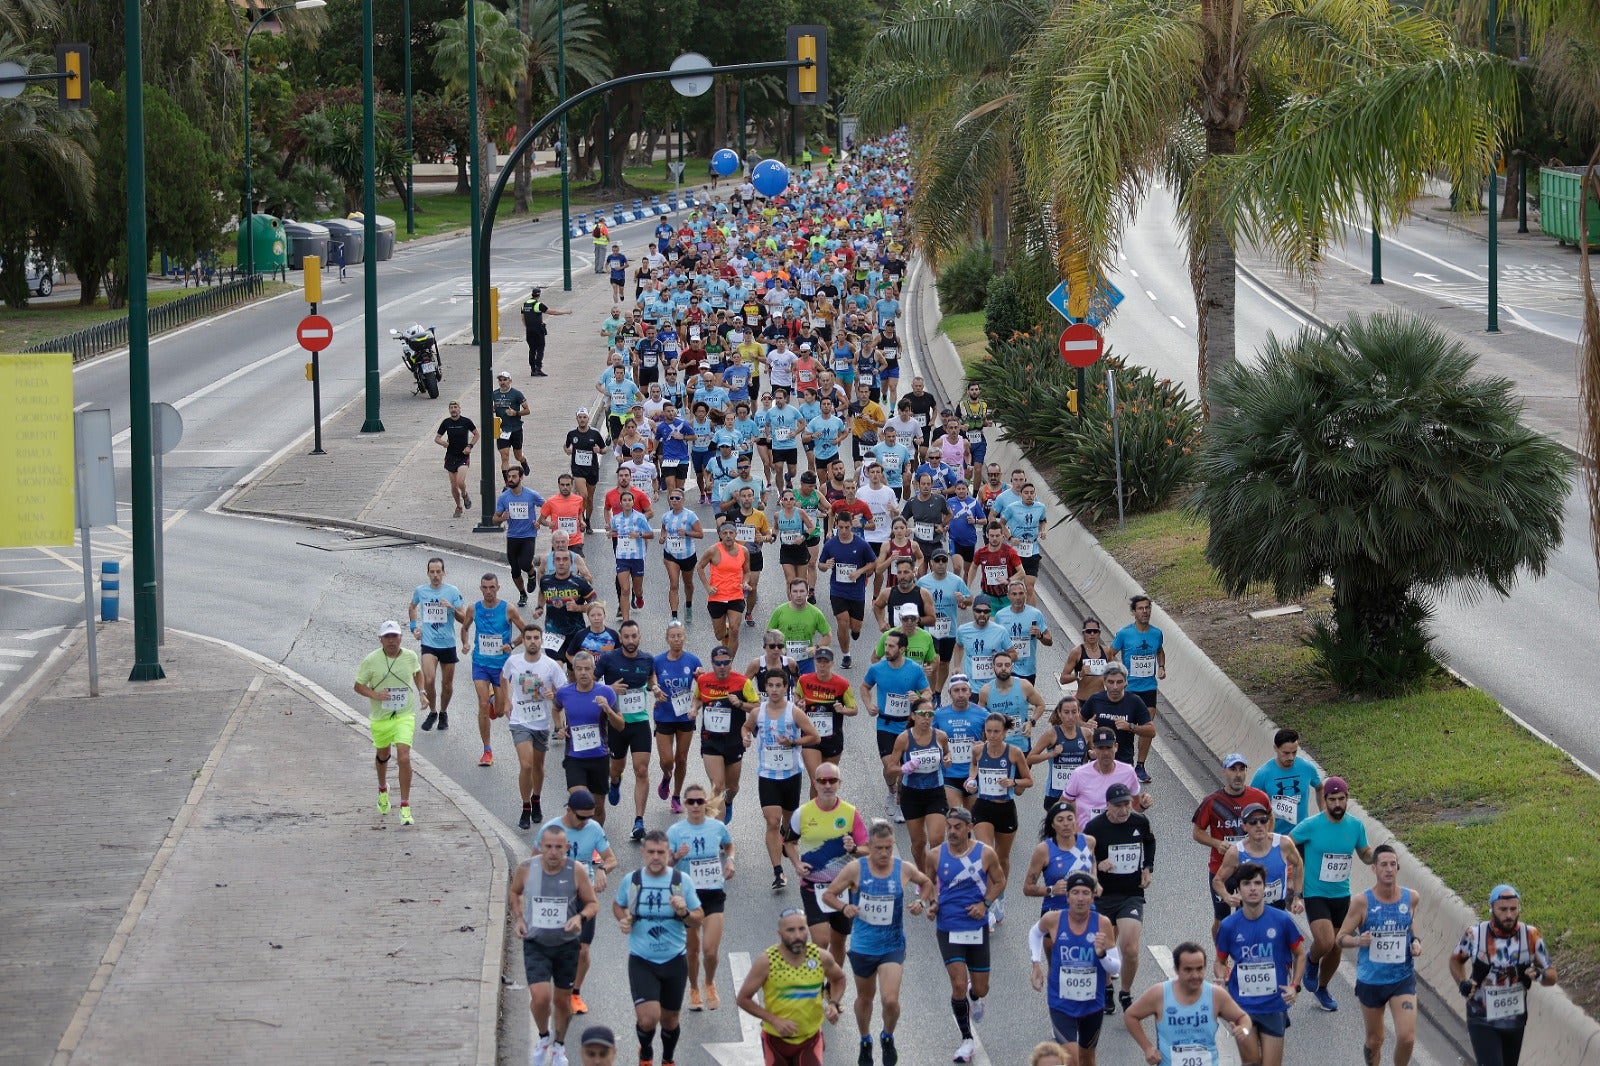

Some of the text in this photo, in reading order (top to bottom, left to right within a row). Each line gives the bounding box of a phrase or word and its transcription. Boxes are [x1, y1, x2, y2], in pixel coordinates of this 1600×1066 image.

[15, 396, 59, 405] MURILLO
[664, 677, 690, 688] RCM
[522, 705, 542, 714] 1164
[711, 715, 724, 723] 177
[952, 743, 972, 754] 1017
[773, 753, 784, 762] 35
[1276, 802, 1293, 814] 6592
[1114, 852, 1137, 863] 1180
[693, 867, 721, 877] 11546
[1327, 862, 1348, 872] 6872
[541, 908, 559, 917] 202
[864, 903, 888, 913] 6161
[1241, 943, 1273, 958] RCM
[1376, 941, 1400, 950] 6571
[1060, 946, 1094, 962] RCM
[1066, 978, 1092, 988] 6055
[1244, 973, 1271, 983] 6056
[1493, 997, 1519, 1009] 6655
[1167, 1011, 1209, 1028] nerja
[1182, 1056, 1203, 1066] 203
